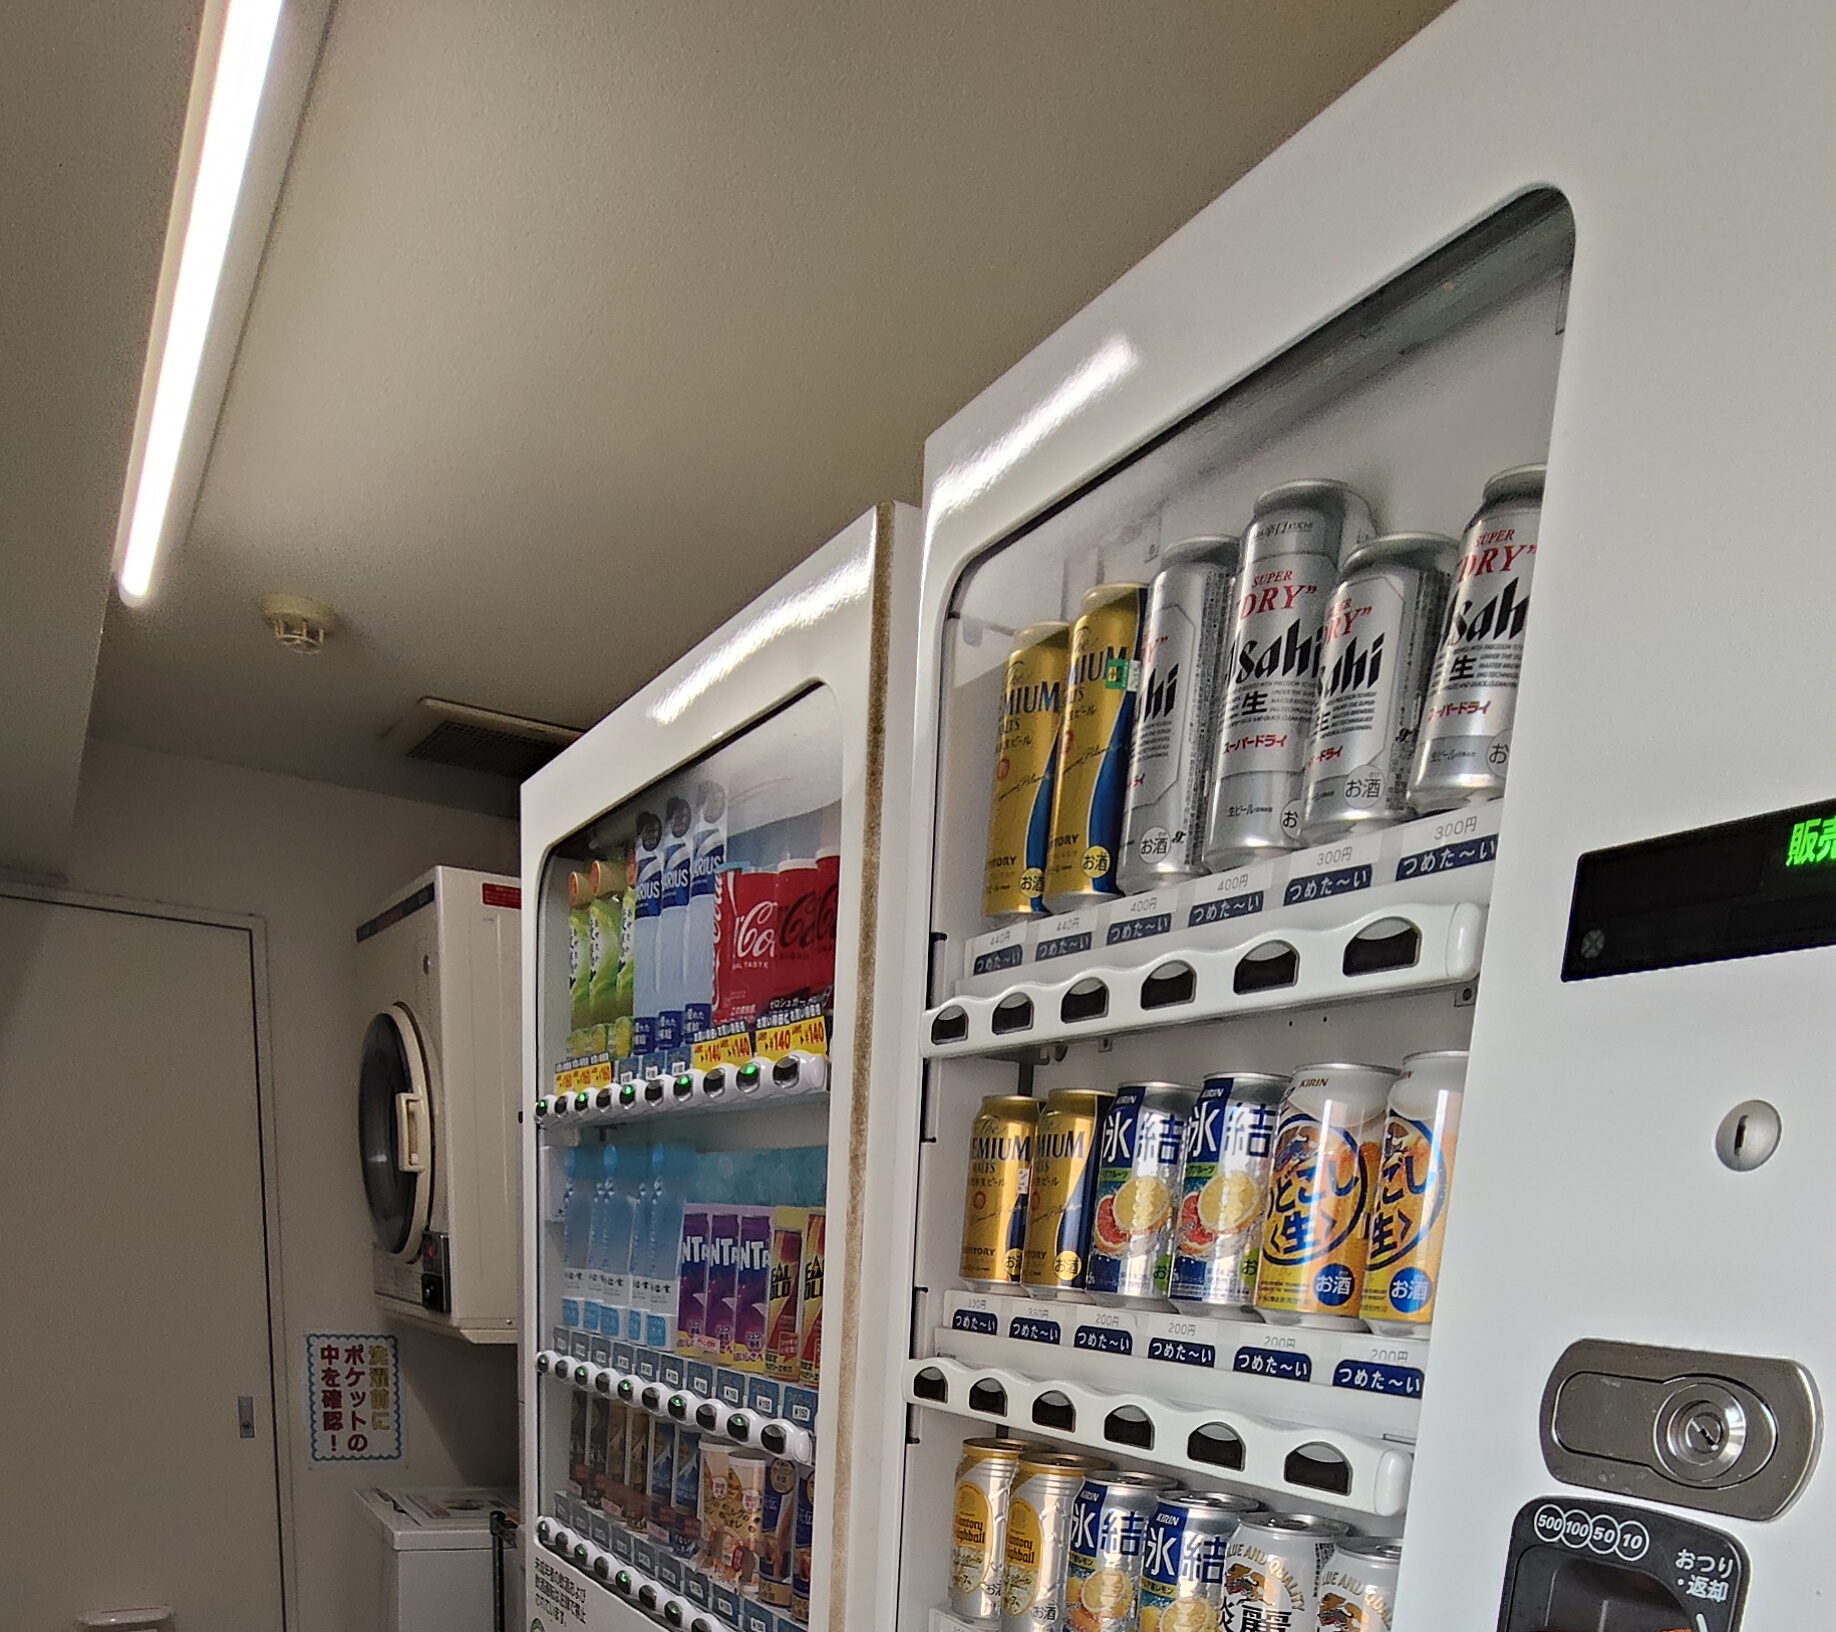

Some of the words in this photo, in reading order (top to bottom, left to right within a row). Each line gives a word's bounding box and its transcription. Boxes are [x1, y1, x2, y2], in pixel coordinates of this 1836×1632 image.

[1476, 528, 1515, 546] SUPER
[1252, 570, 1294, 588] SUPER
[1443, 576, 1530, 647] sah
[1328, 632, 1386, 697] ahi
[1449, 654, 1478, 681] 生
[1004, 681, 1061, 716] MIUM
[1241, 690, 1269, 716] 生
[1488, 745, 1510, 764] お
[1345, 778, 1382, 799] お酒
[1282, 809, 1300, 829] お
[1433, 815, 1478, 841] 300円
[1140, 837, 1168, 855] お酒
[1316, 846, 1353, 867] 300円
[1081, 854, 1109, 872] お酒
[1402, 840, 1497, 876] つめた～い
[637, 880, 660, 901] RIUS
[1019, 875, 1045, 892] お酒
[1217, 874, 1250, 892] 400円
[1288, 868, 1369, 899] つめた～い
[1130, 896, 1158, 912] 400円
[1193, 895, 1261, 922] つめた～い
[1300, 1078, 1329, 1089] KIRIN
[1102, 1111, 1187, 1165] 氷結
[1189, 1101, 1277, 1158] 氷結
[971, 1134, 1032, 1163] EMIUM
[1036, 1130, 1085, 1160] MIUM
[1371, 1208, 1413, 1259] 生〉
[682, 1236, 709, 1264] NTA
[710, 1238, 738, 1267] NTA
[740, 1240, 770, 1271] NTA
[770, 1264, 792, 1281] EAL
[1054, 1257, 1080, 1275] お酒
[1315, 1275, 1352, 1296] お酒
[1391, 1278, 1431, 1301] お酒
[1095, 1313, 1120, 1327] 200円
[1168, 1322, 1196, 1337] 200円
[1151, 1341, 1212, 1363] つめた～い
[1263, 1336, 1296, 1350] 200円
[1237, 1353, 1308, 1377] つめた～い
[1370, 1349, 1409, 1362] 200円
[1338, 1366, 1421, 1393] つめた～い
[344, 1343, 368, 1453] ポケットの
[1080, 1490, 1100, 1502] KIRIN
[1071, 1502, 1145, 1557] 氷結
[1155, 1511, 1180, 1527] KIRIN
[955, 1526, 986, 1545] ghball
[1537, 1513, 1564, 1533] 500
[1564, 1519, 1590, 1539] 100
[1592, 1526, 1617, 1545] 50
[1622, 1532, 1643, 1551] 10
[1145, 1526, 1228, 1585] 氷結
[1675, 1548, 1734, 1578] おつり
[1243, 1545, 1268, 1566] AND
[1268, 1559, 1306, 1612] QUALITY
[1032, 1605, 1057, 1621] お酒
[1339, 1574, 1365, 1597] AND
[1364, 1590, 1393, 1632] QUAL
